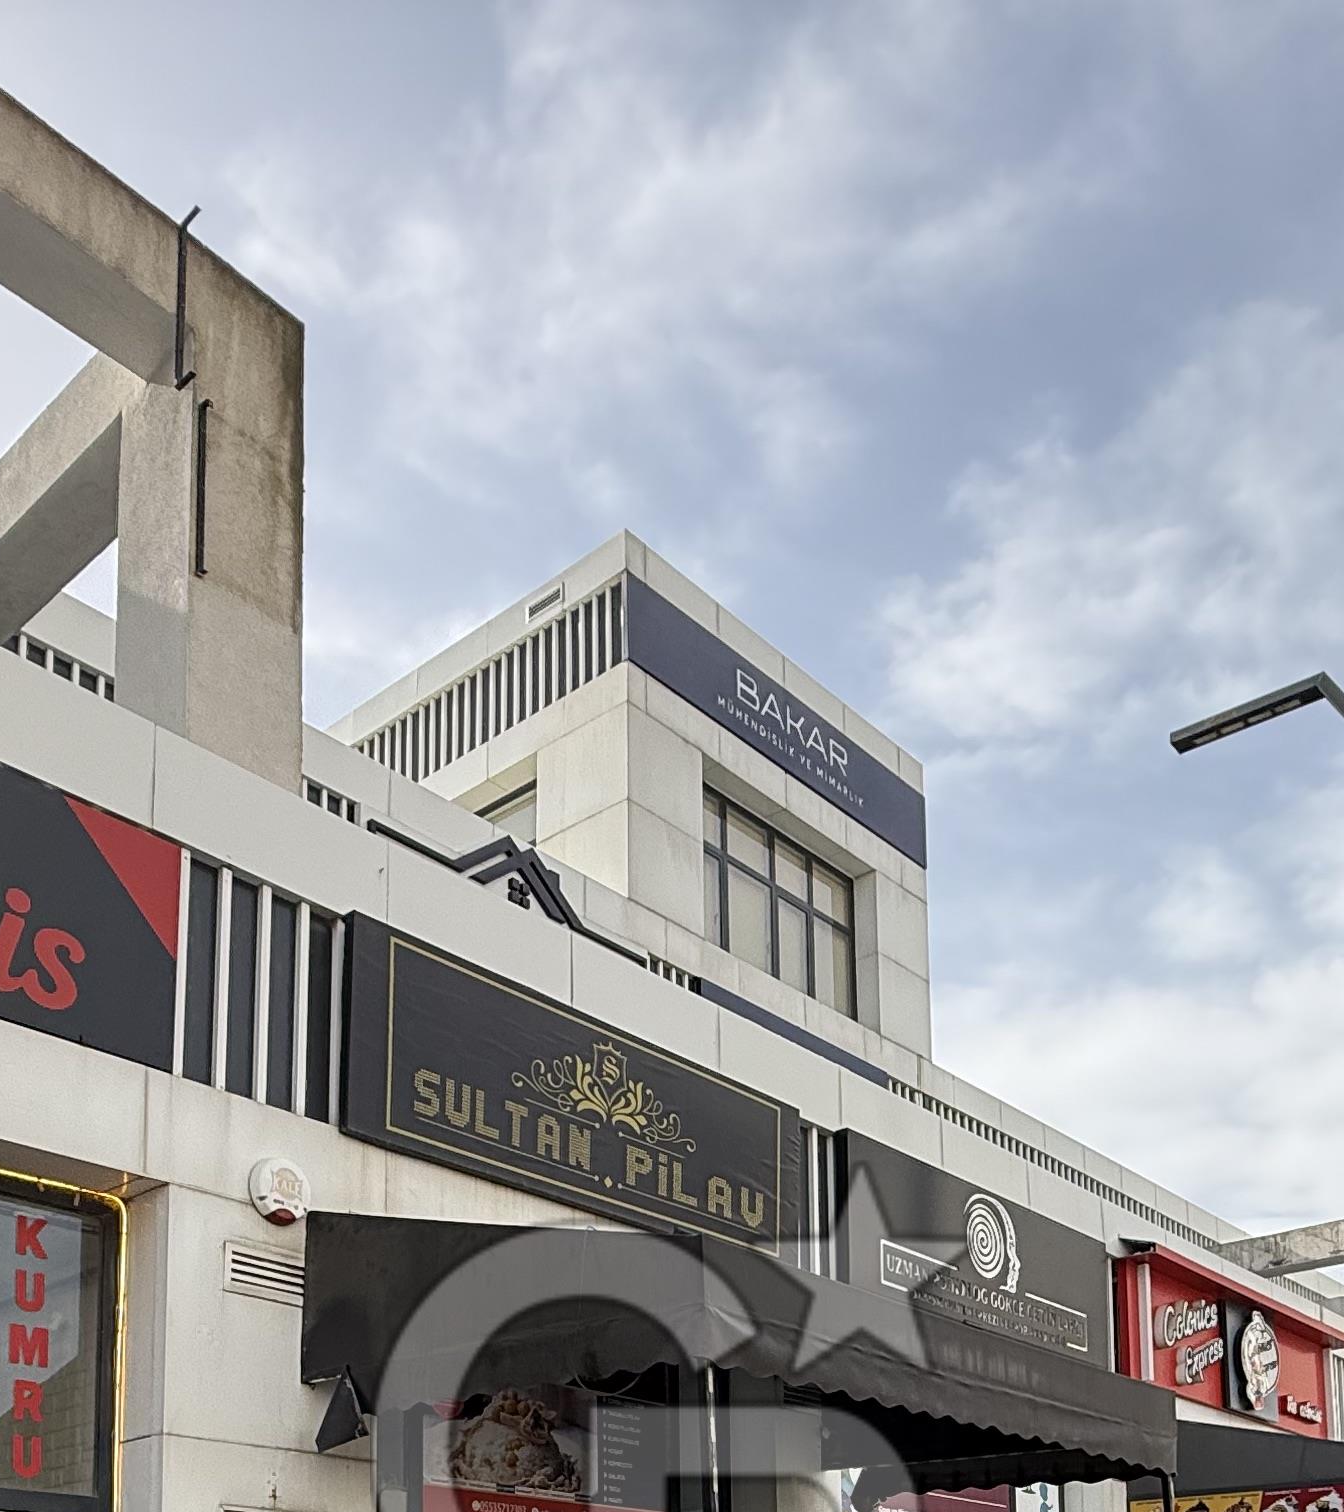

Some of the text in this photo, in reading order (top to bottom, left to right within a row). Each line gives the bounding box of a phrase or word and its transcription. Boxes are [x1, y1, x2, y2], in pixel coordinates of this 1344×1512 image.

[736, 668, 849, 777] BAKAR
[413, 1067, 593, 1171] SULTAN
[8, 1214, 49, 1480] KUMRU
[1185, 1337, 1224, 1385] Express
